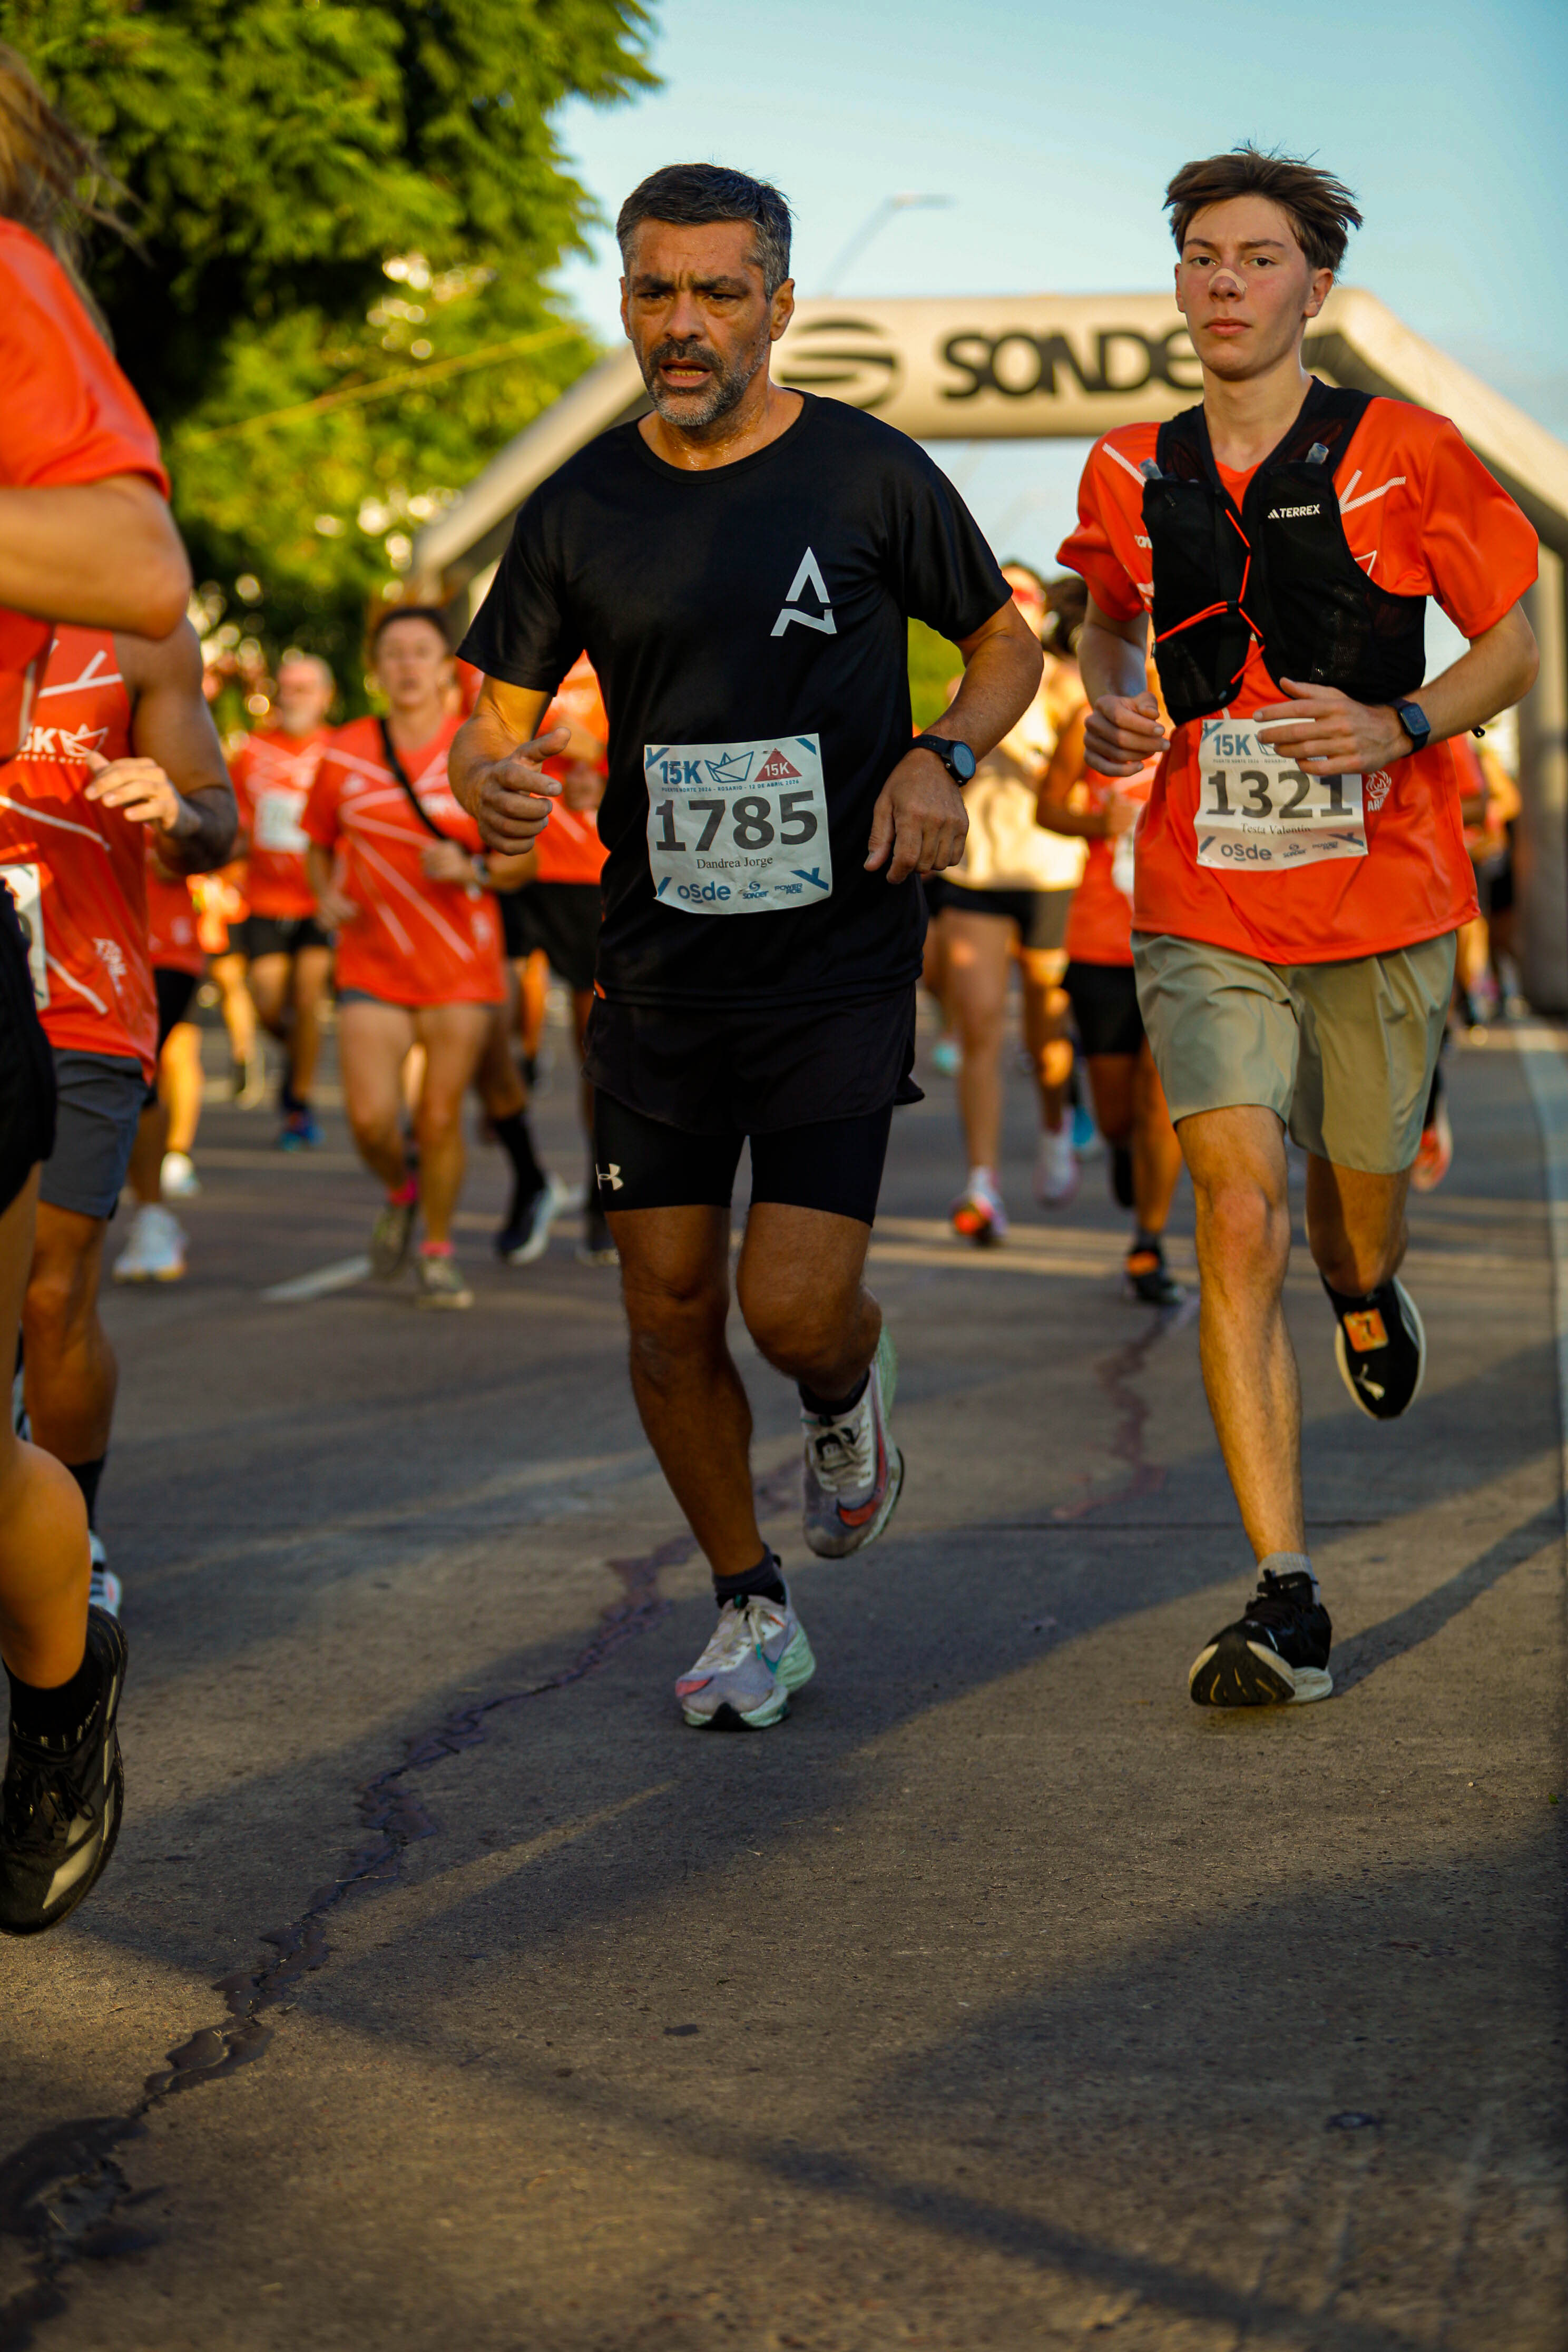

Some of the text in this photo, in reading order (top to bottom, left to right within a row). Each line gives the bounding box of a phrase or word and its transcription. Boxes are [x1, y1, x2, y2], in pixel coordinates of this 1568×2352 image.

[1279, 504, 1320, 518] TERREX
[1213, 733, 1252, 756] 15K
[659, 760, 702, 784] 15K
[764, 761, 791, 777] 15K
[1206, 770, 1353, 819] 1321
[655, 790, 818, 851] 1785
[1241, 822, 1266, 834] Testa
[1220, 843, 1272, 861] osde
[696, 857, 773, 869] Dandrea Jorge
[677, 880, 731, 903] osde
[775, 883, 803, 891] POWER
